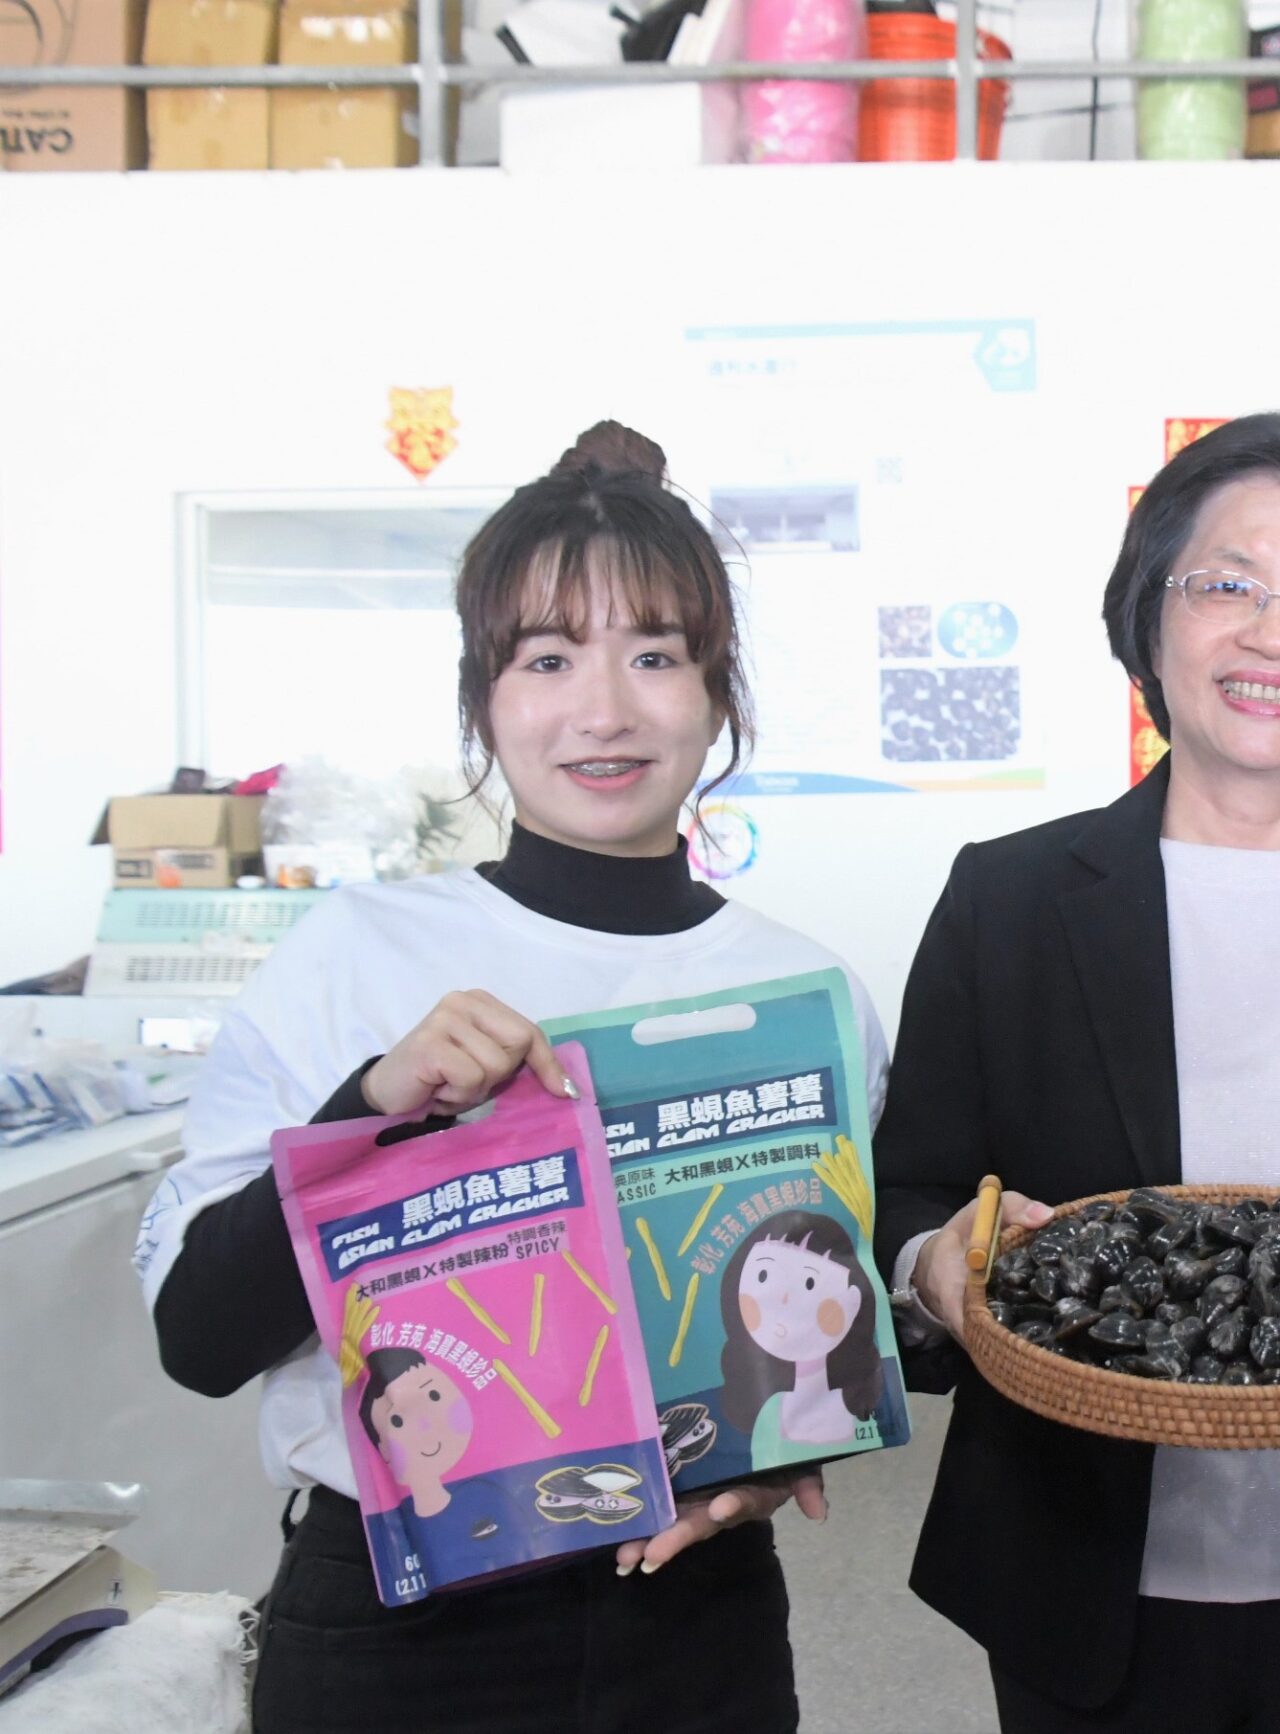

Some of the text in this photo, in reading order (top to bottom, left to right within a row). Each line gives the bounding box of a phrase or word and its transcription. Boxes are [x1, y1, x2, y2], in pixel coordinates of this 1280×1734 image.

[657, 1073, 823, 1133] 黑蜆魚薯薯
[606, 1104, 825, 1158] SIAN CLAM CRACKER
[614, 1167, 656, 1187] 典原味
[402, 1155, 567, 1229] 黑蜆魚薯薯
[616, 1183, 657, 1204] ASSIC
[331, 1222, 381, 1250] FISH
[338, 1187, 570, 1270] ASIAN CLAM CRACKER
[507, 1220, 567, 1245] 特調香辣
[516, 1237, 561, 1260] SPICY
[370, 1321, 396, 1347] 彰化
[397, 1321, 428, 1349] 芳苑
